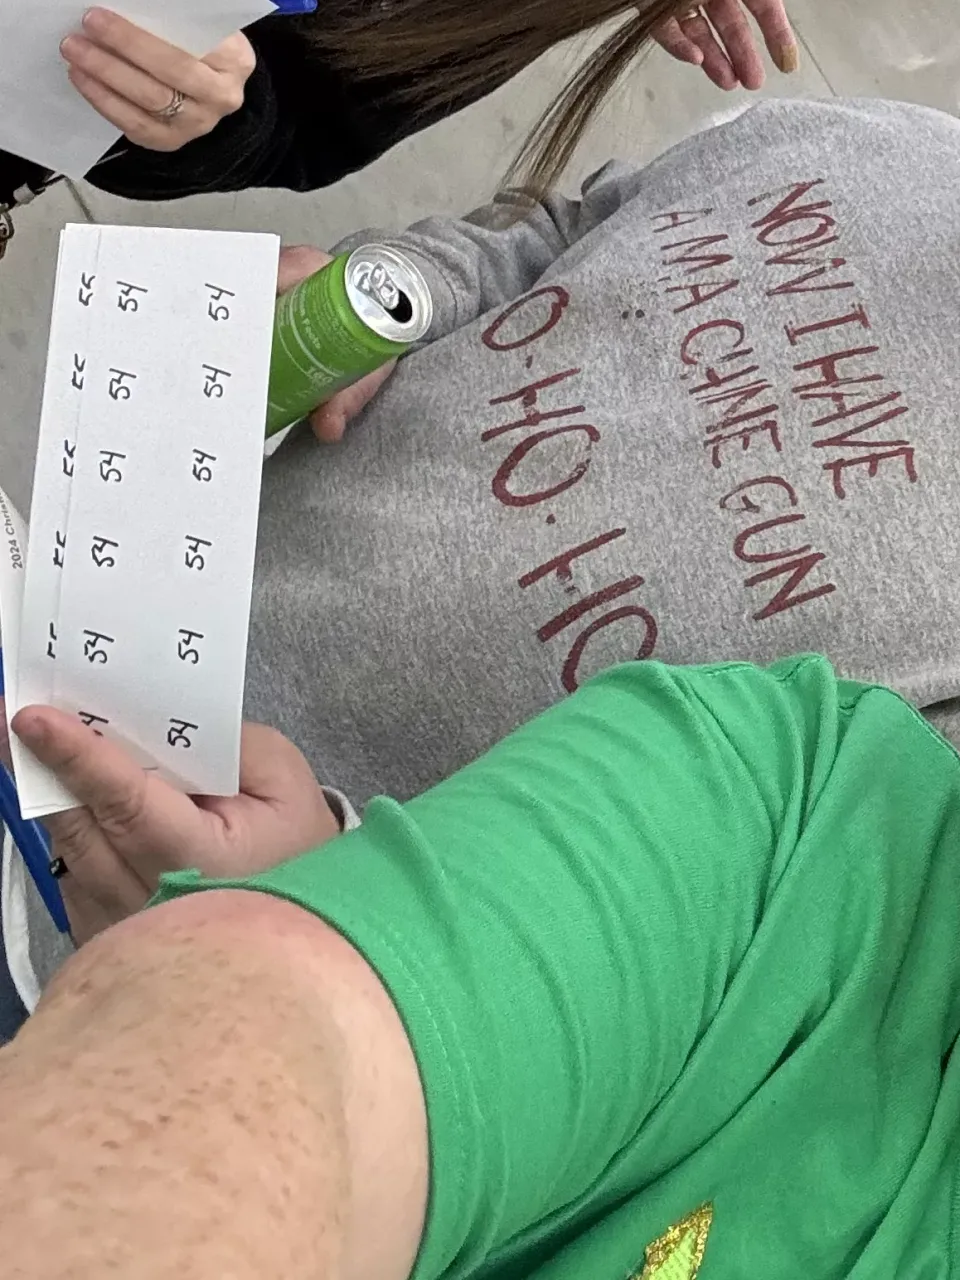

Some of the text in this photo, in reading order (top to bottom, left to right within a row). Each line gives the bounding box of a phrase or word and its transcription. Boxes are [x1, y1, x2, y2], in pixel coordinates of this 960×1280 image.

[115, 279, 149, 313] 54
[747, 177, 918, 500] NOW I HAVE
[108, 367, 137, 401] 54
[99, 449, 127, 483] 54
[166, 282, 236, 749] 54 54 54 54 54 54
[8, 539, 24, 570] 2024
[90, 534, 120, 568] 54
[718, 474, 837, 622] GUN
[82, 629, 115, 664] 54
